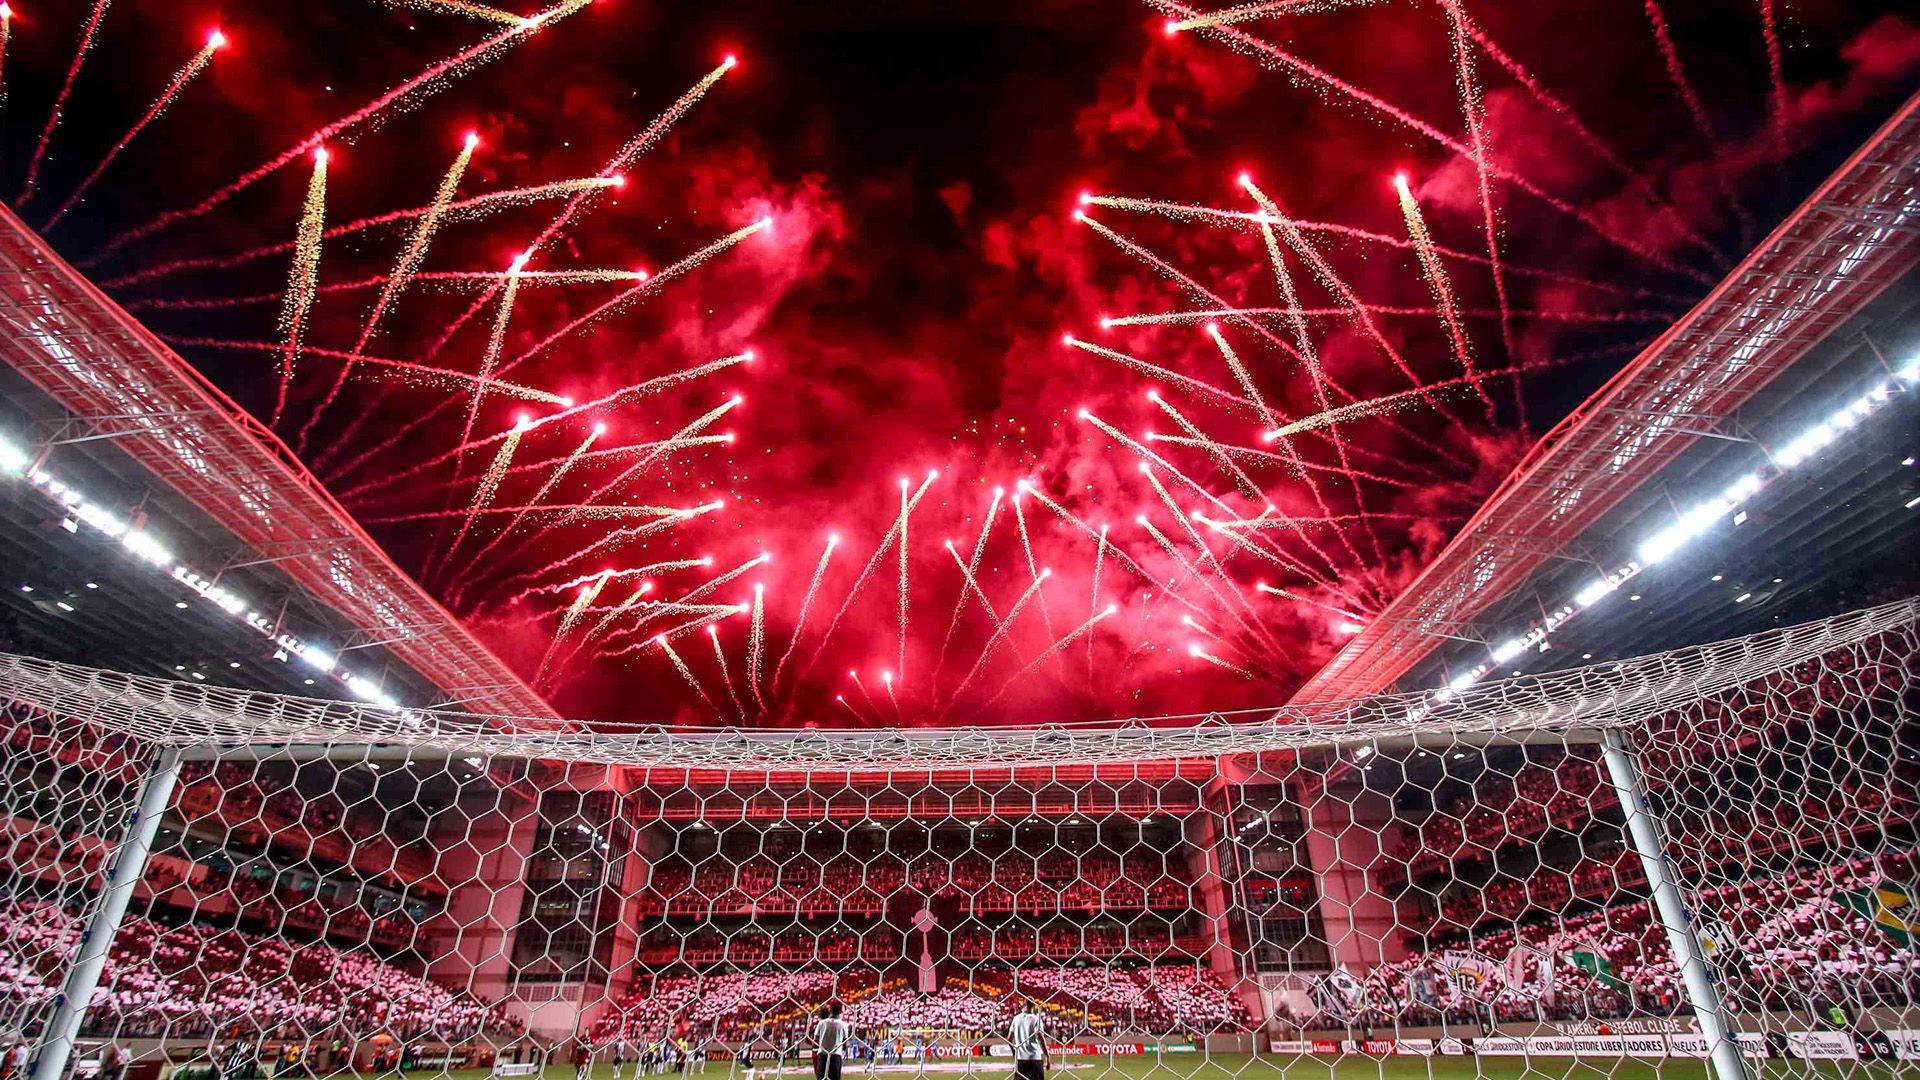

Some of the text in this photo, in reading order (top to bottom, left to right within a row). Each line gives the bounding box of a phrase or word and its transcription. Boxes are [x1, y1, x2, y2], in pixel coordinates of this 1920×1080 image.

[1647, 1019, 1682, 1034] CLUBE
[1095, 1044, 1138, 1054] TOYOTA
[1367, 1041, 1393, 1053] TOYOTA
[1535, 1041, 1553, 1052] COPA
[1600, 1040, 1662, 1052] LIBERTADORES
